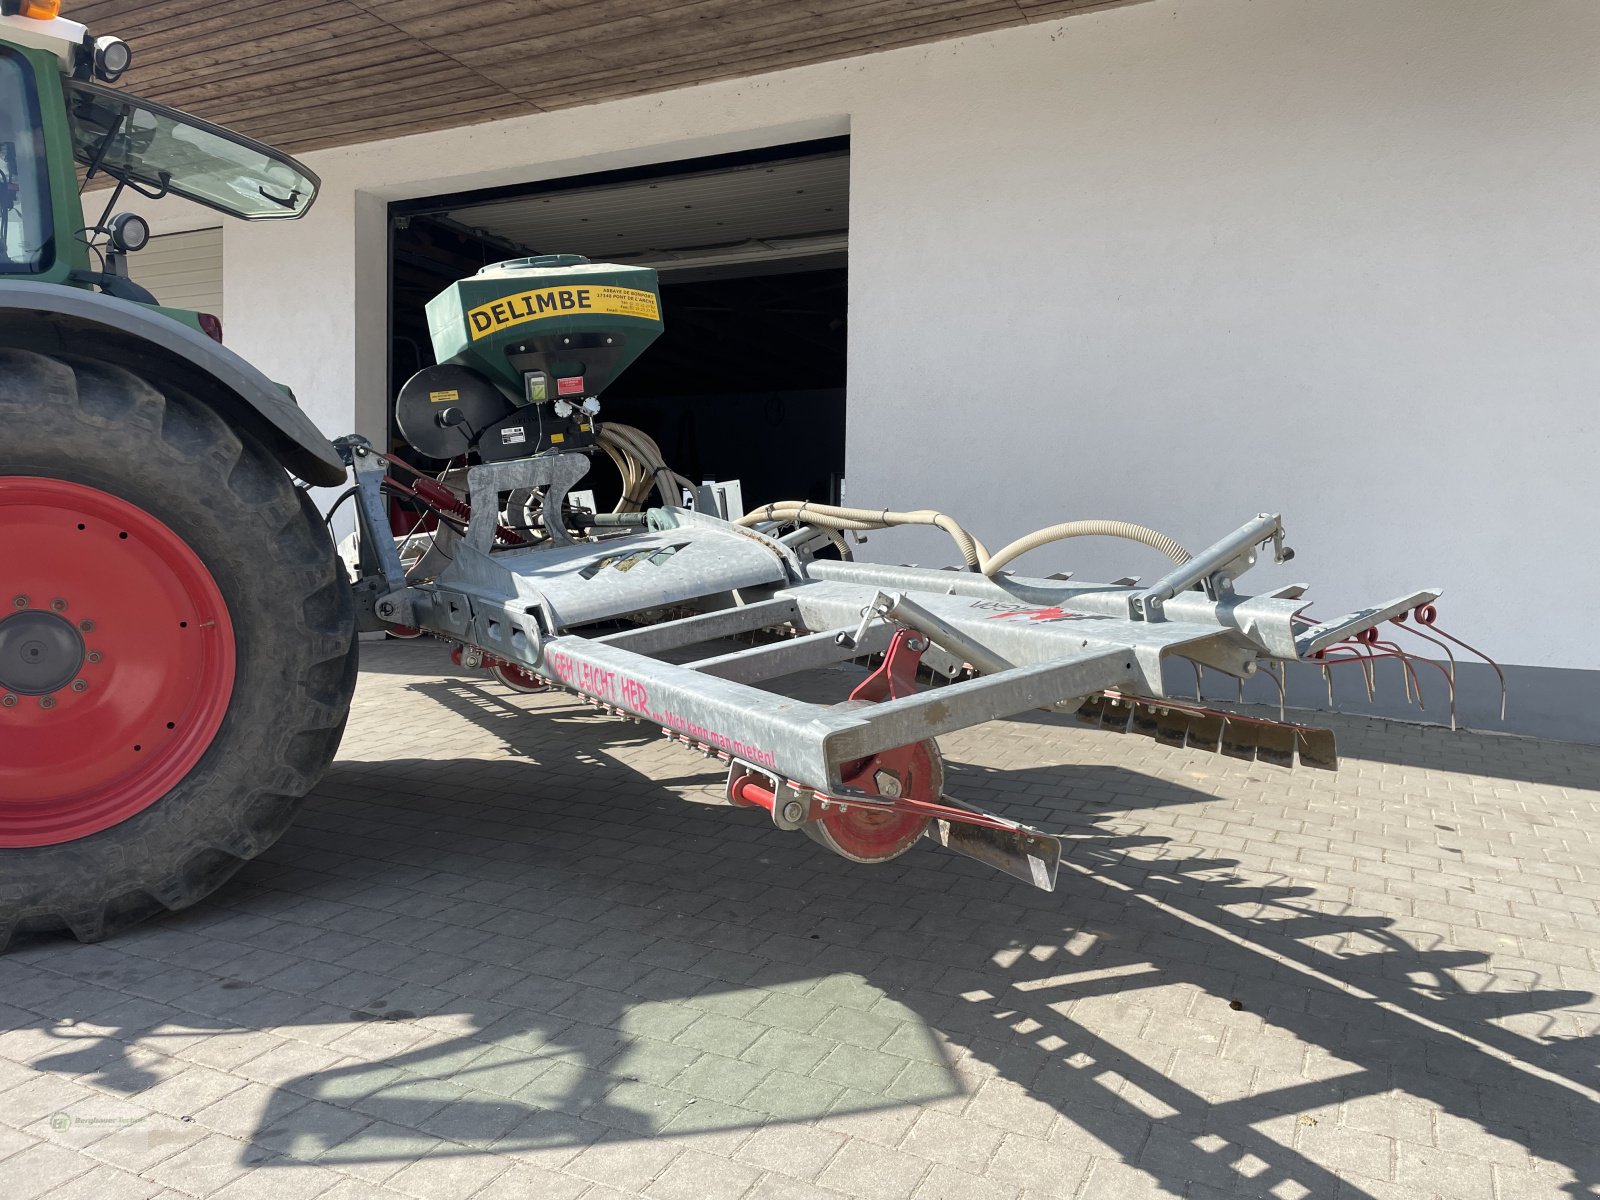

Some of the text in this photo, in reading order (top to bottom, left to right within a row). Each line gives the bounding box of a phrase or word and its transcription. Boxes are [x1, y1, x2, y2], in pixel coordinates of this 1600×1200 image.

[471, 290, 592, 332] DELIMBE
[554, 652, 575, 685] GEH
[576, 661, 617, 702] LEICHT
[621, 676, 650, 716] HER
[686, 716, 710, 741] kann
[710, 730, 733, 753] man
[733, 737, 777, 770] mieten!
